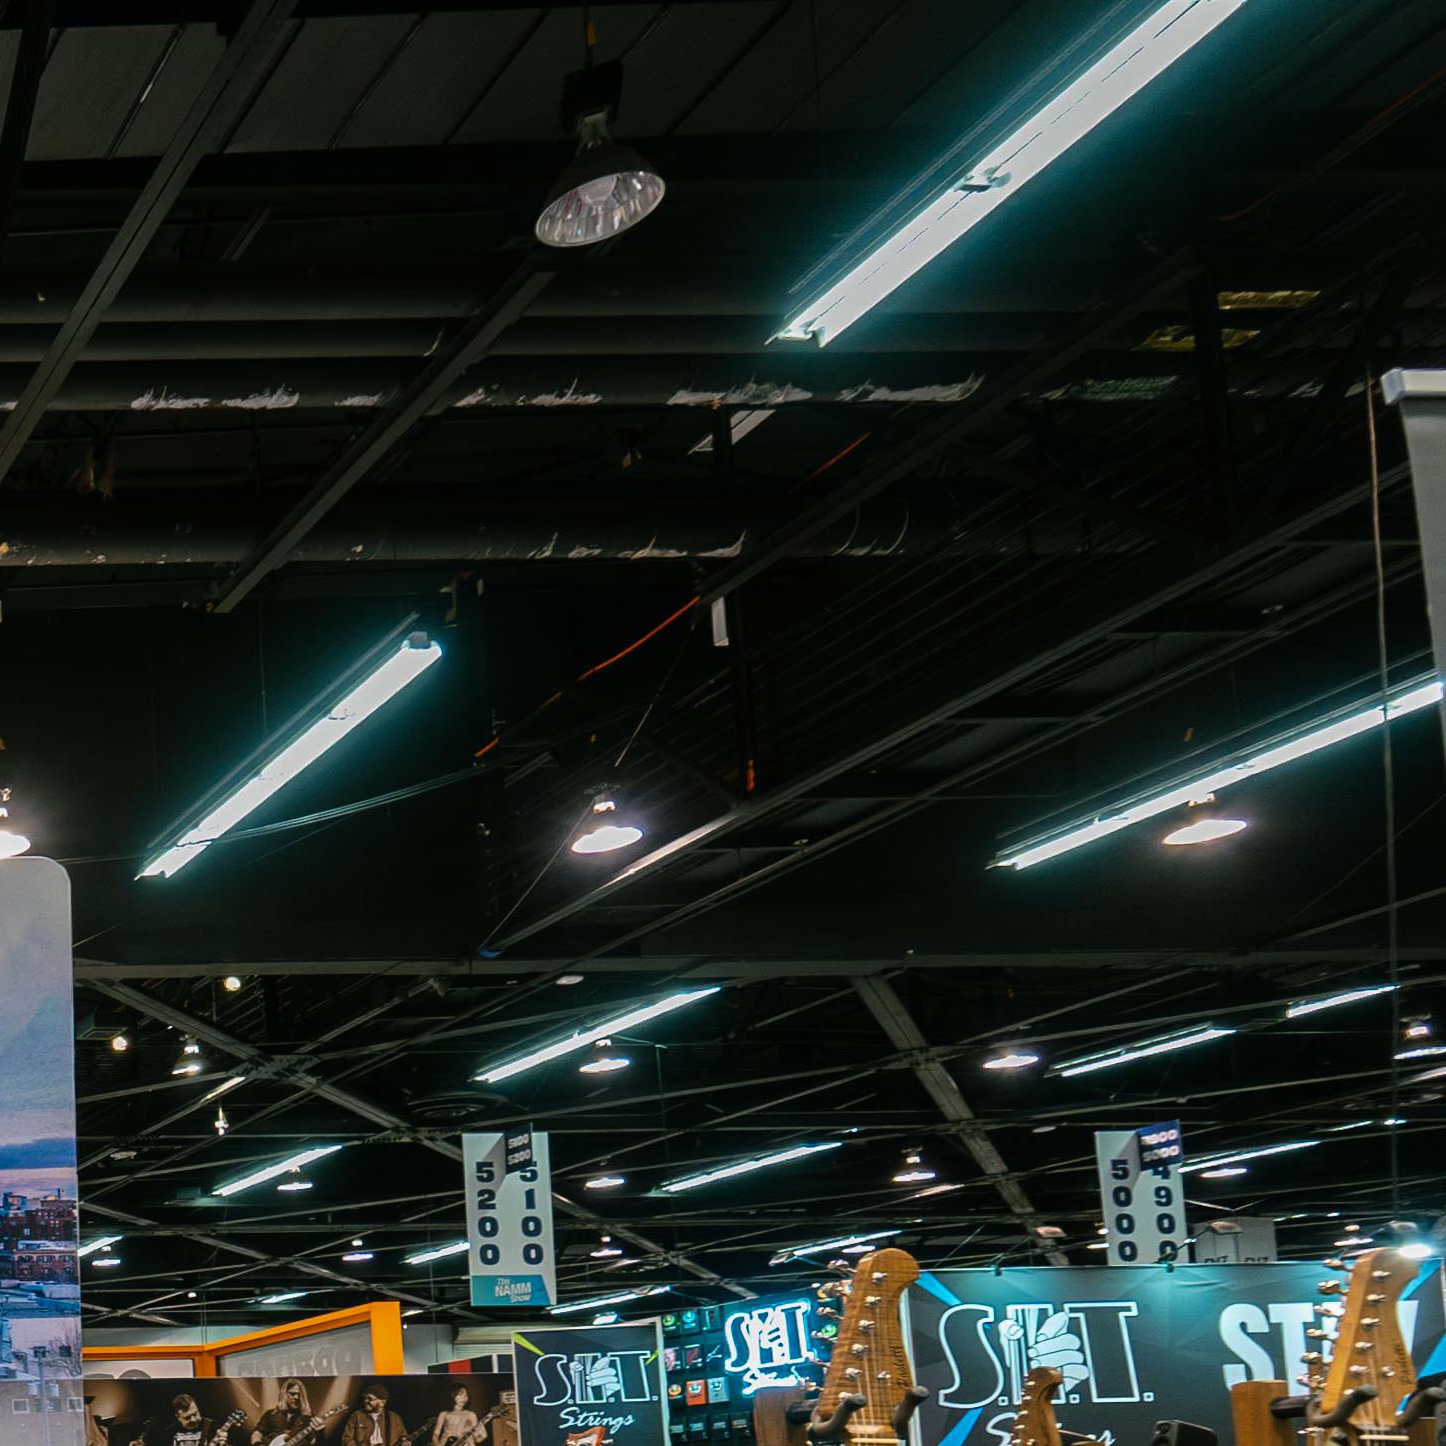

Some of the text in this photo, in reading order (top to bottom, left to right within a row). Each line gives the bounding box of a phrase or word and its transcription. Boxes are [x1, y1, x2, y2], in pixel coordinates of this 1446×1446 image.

[475, 1161, 500, 1265] 5200
[519, 1161, 544, 1265] 5100
[1110, 1159, 1138, 1262] 5000
[495, 1282, 532, 1297] NAMM
[559, 1406, 635, 1434] Strings
